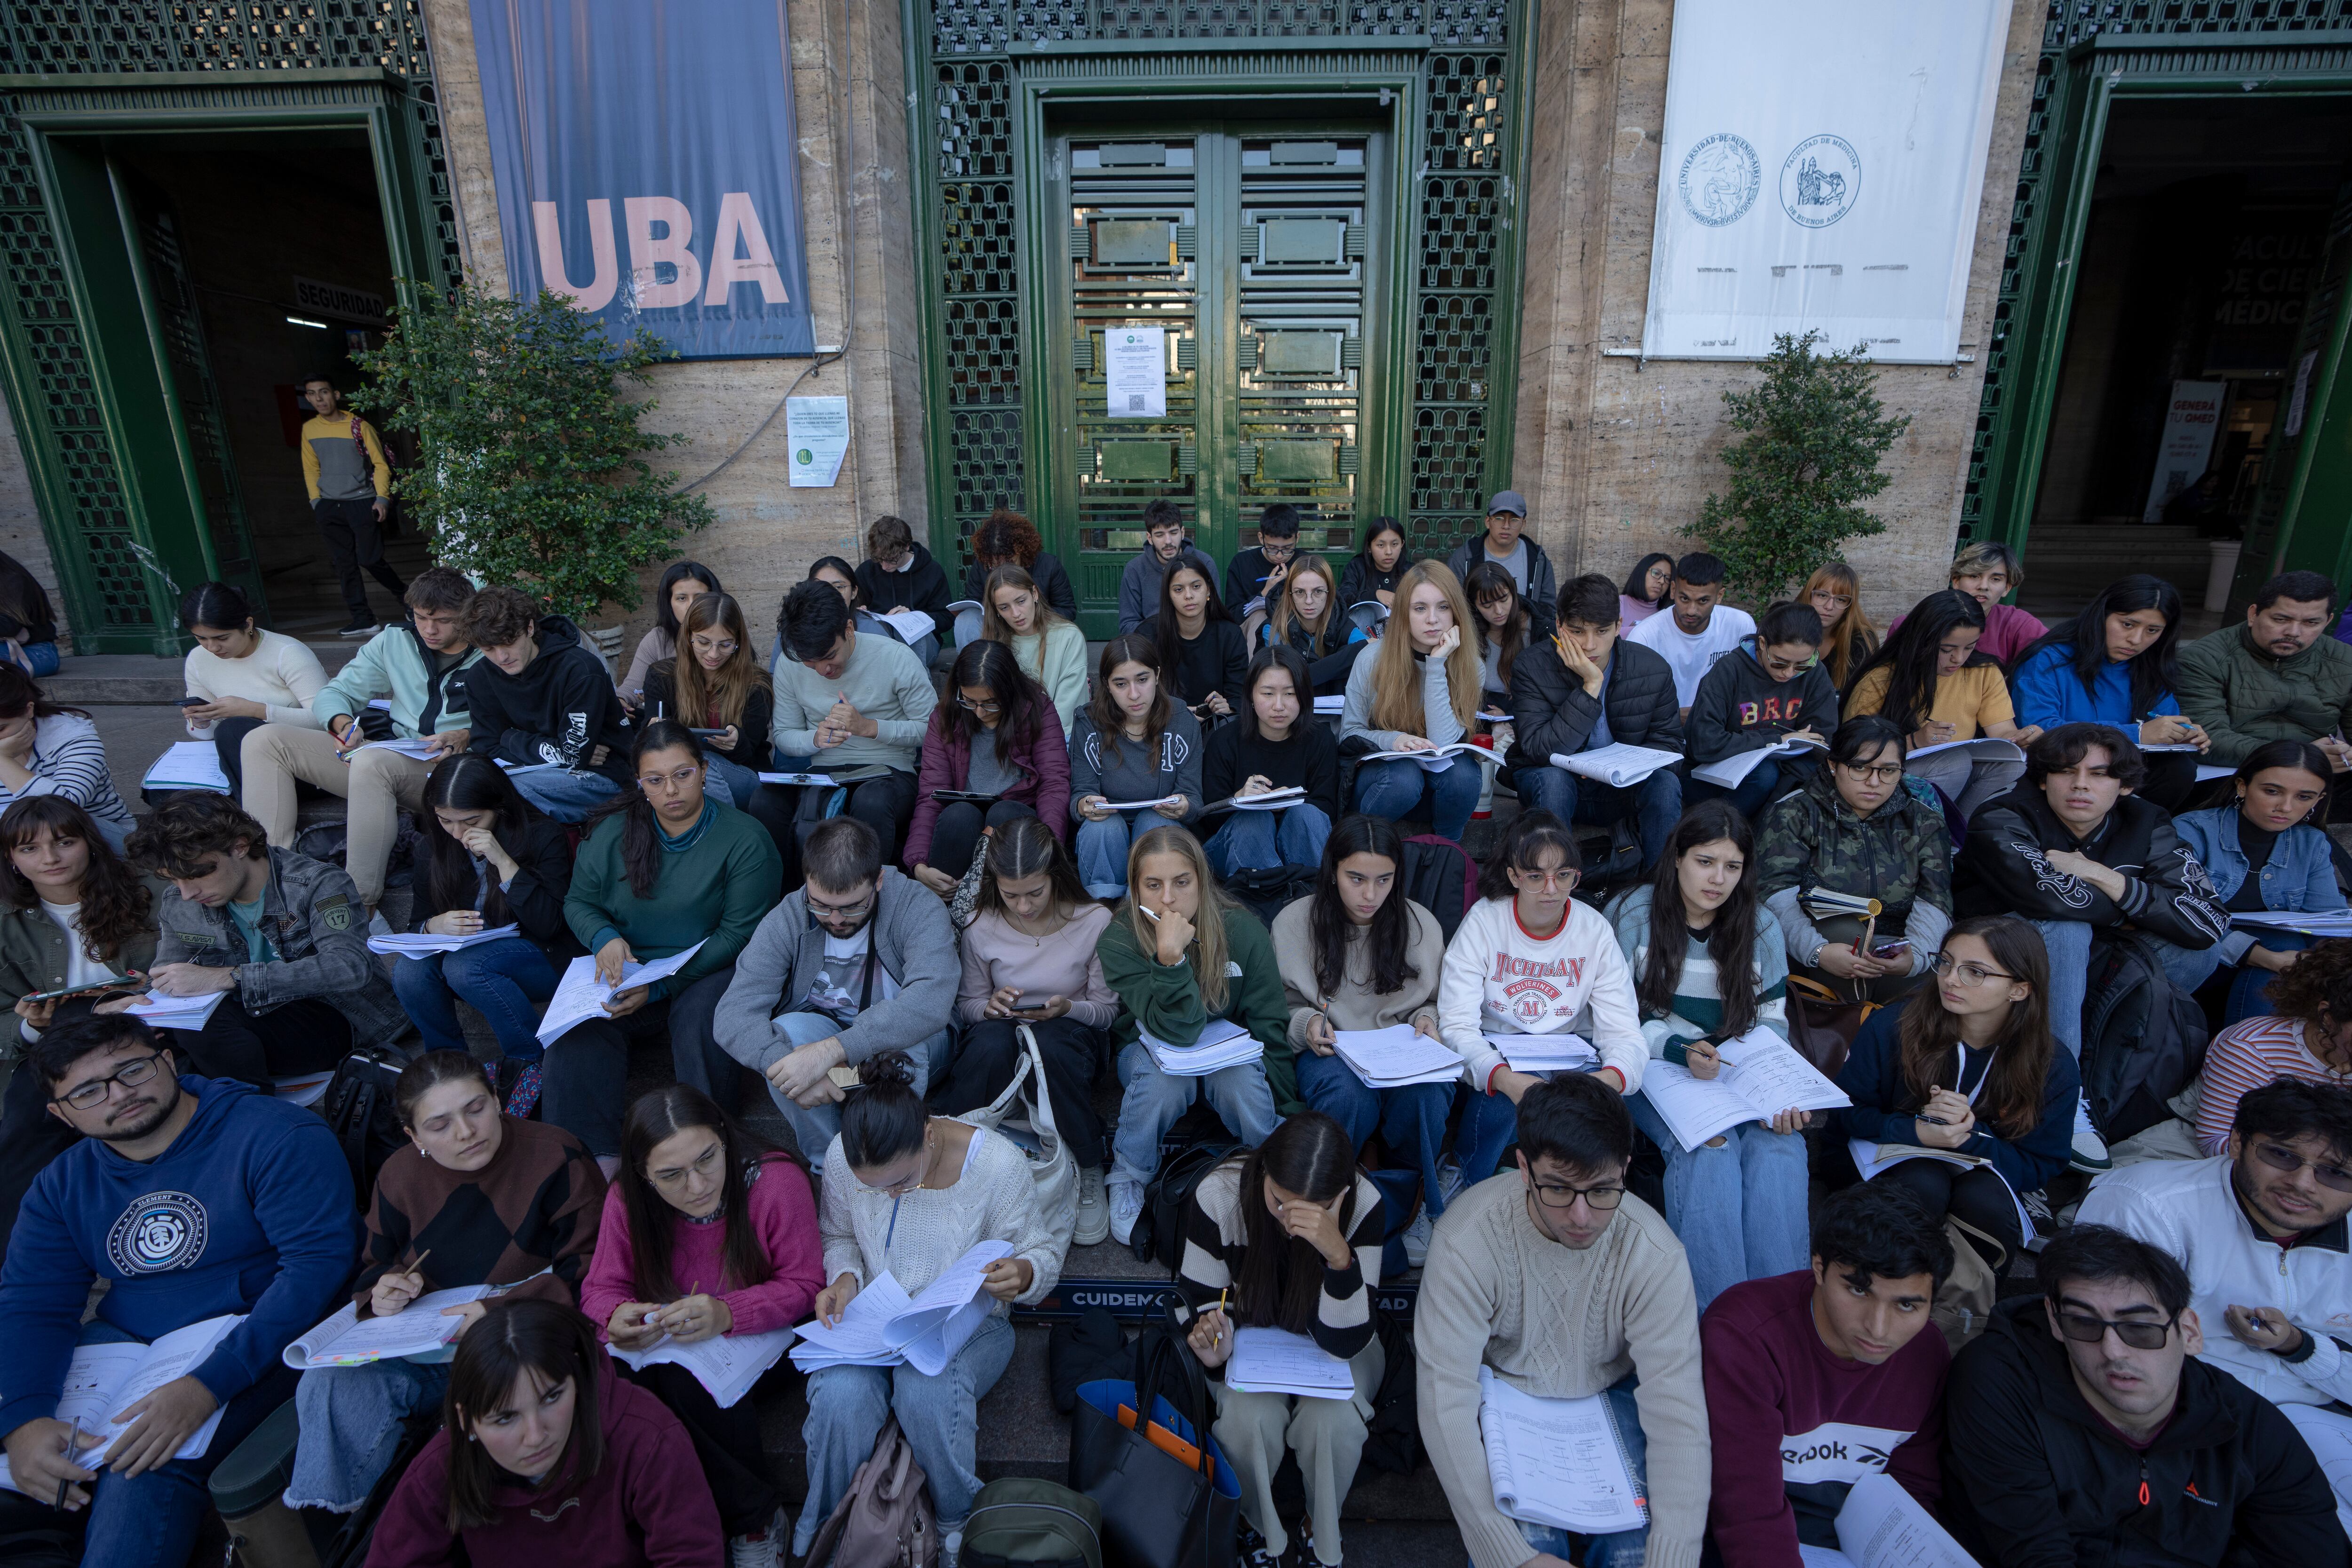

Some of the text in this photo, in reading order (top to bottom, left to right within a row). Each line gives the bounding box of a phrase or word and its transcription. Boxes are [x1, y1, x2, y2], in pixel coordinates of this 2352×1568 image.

[1680, 137, 1716, 185] UNIVERSIDAD
[1731, 135, 1756, 159] BUENOS
[1751, 160, 1760, 186] AIRES
[1786, 139, 1819, 168] FACULTAD
[1832, 139, 1858, 170] MEDICINA
[1788, 205, 1846, 225] DE BUENOS AIRES
[532, 192, 789, 312] UBA
[298, 282, 383, 318] SEGURIDAD
[2174, 399, 2216, 411] GENERÁ
[2169, 413, 2183, 422] TU
[1739, 696, 1803, 726] BRC
[332, 915, 346, 926] 17
[1491, 951, 1585, 987] MICHIGAN
[1510, 981, 1555, 995] WOLVERINES
[1513, 992, 1530, 1007] TRADITION
[1531, 992, 1547, 1008] TRADITION
[1521, 1001, 1539, 1016] M
[1512, 1008, 1527, 1025] TRADITION
[1530, 1010, 1548, 1025] TRADITION
[137, 1194, 172, 1206] ELEMENT
[1375, 1297, 1408, 1310] AD
